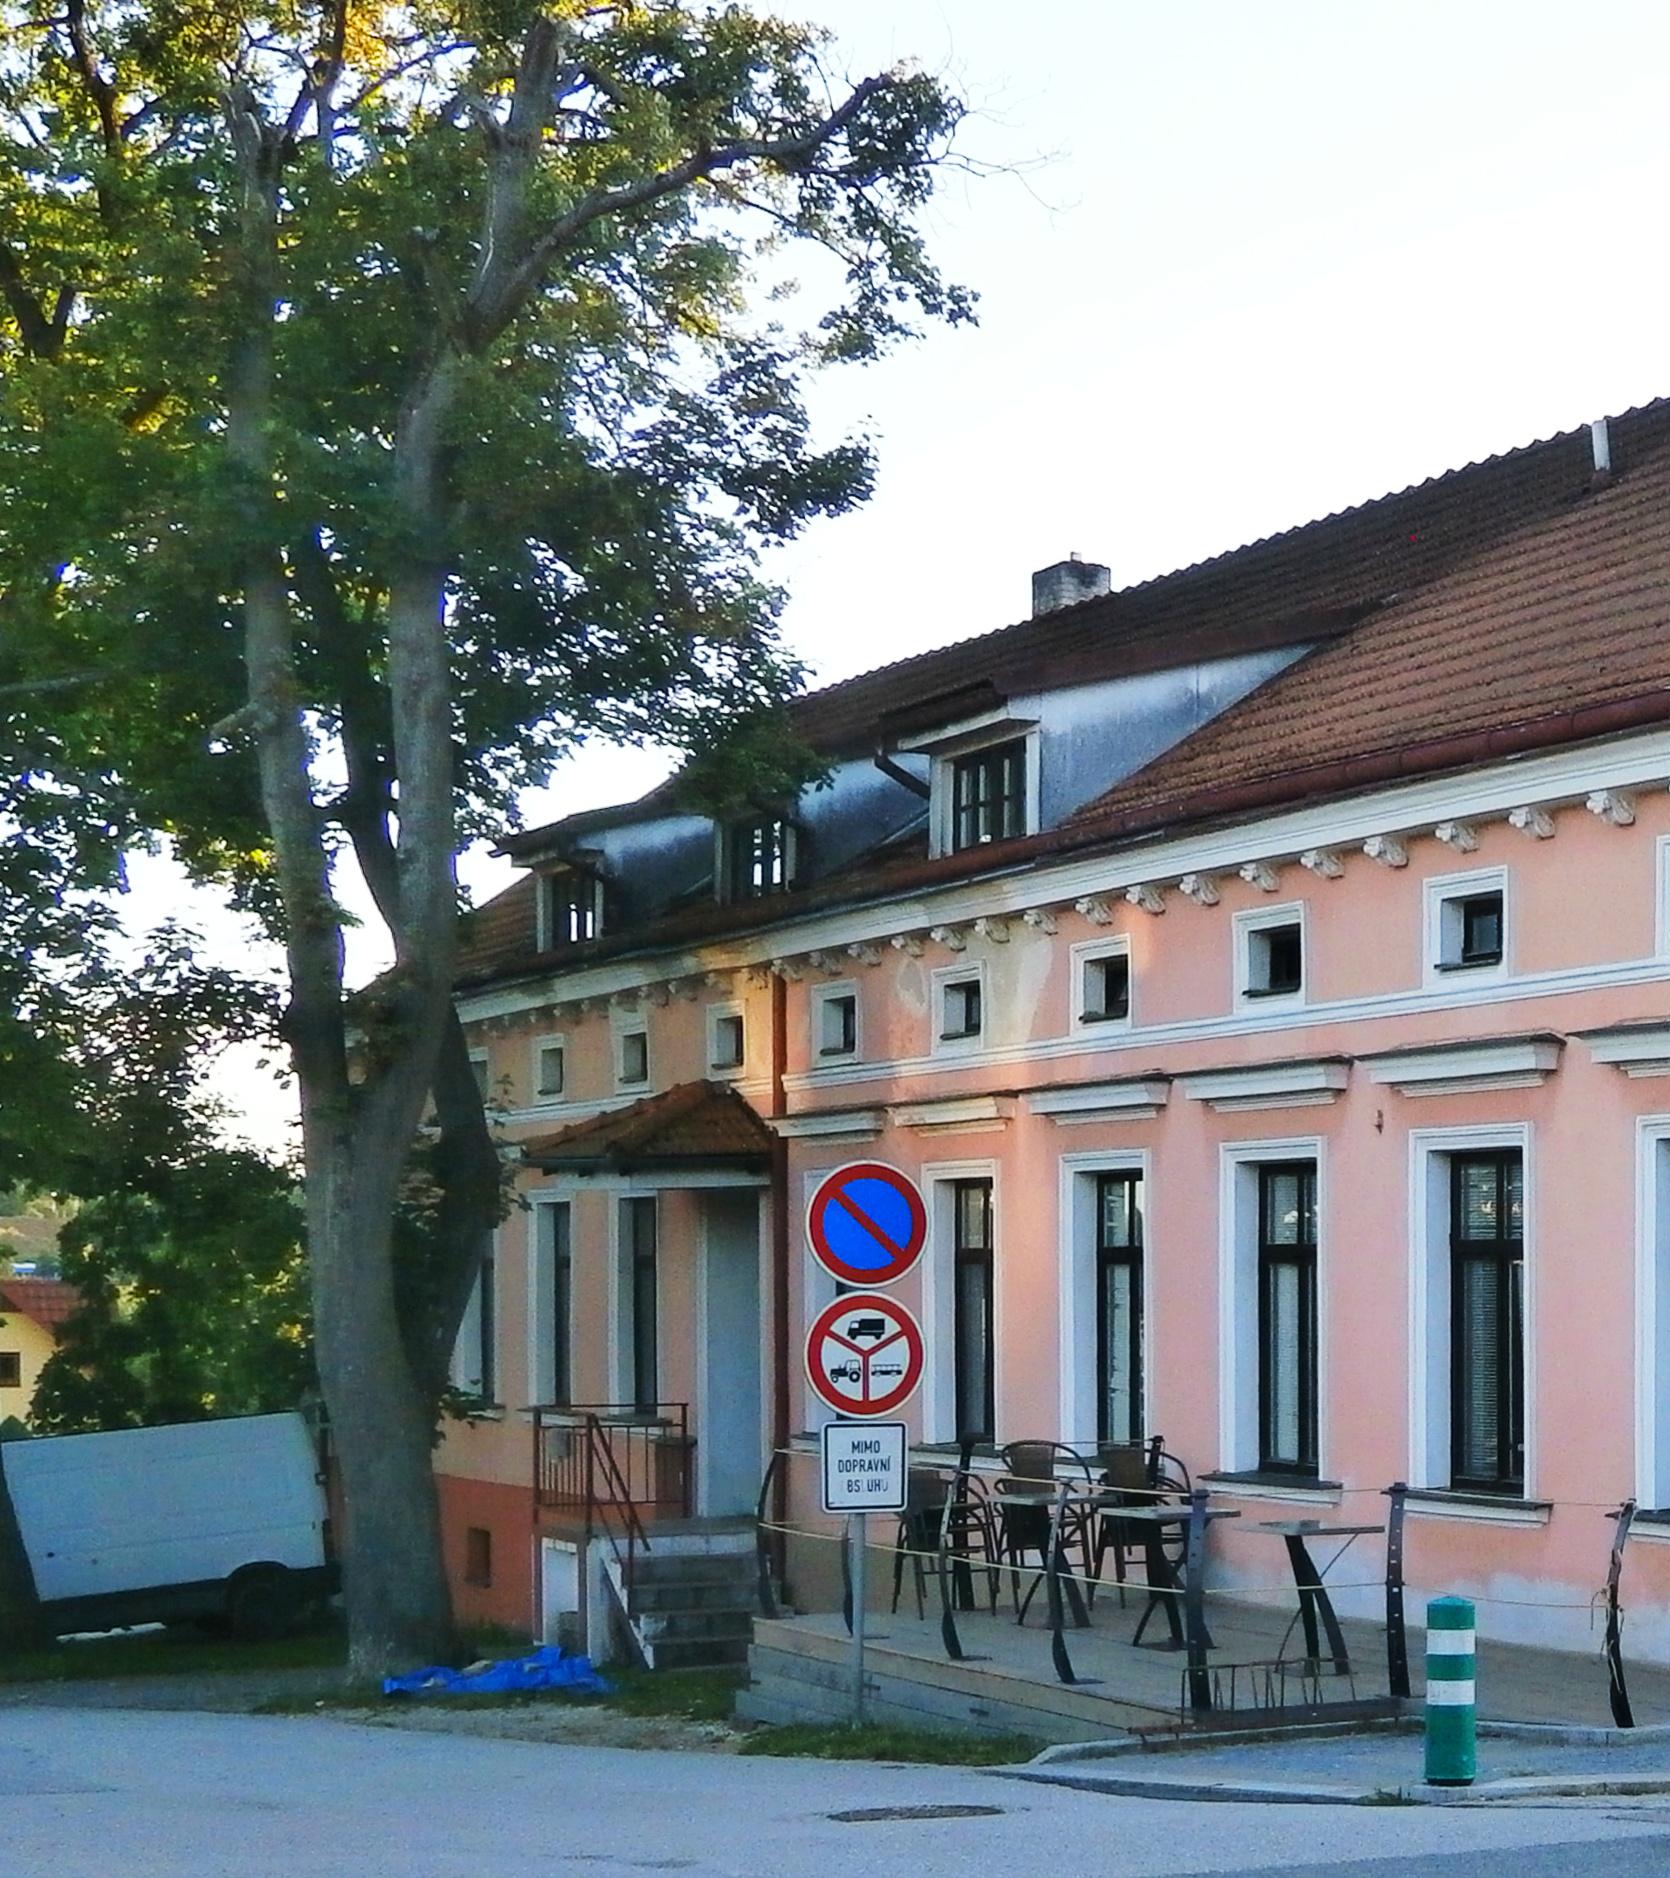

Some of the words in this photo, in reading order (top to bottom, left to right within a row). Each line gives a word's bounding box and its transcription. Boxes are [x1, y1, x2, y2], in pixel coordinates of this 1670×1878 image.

[851, 1440, 881, 1454] MIMO
[838, 1456, 891, 1473] DOPRAVNÍ
[840, 1479, 889, 1493] BSUHU
